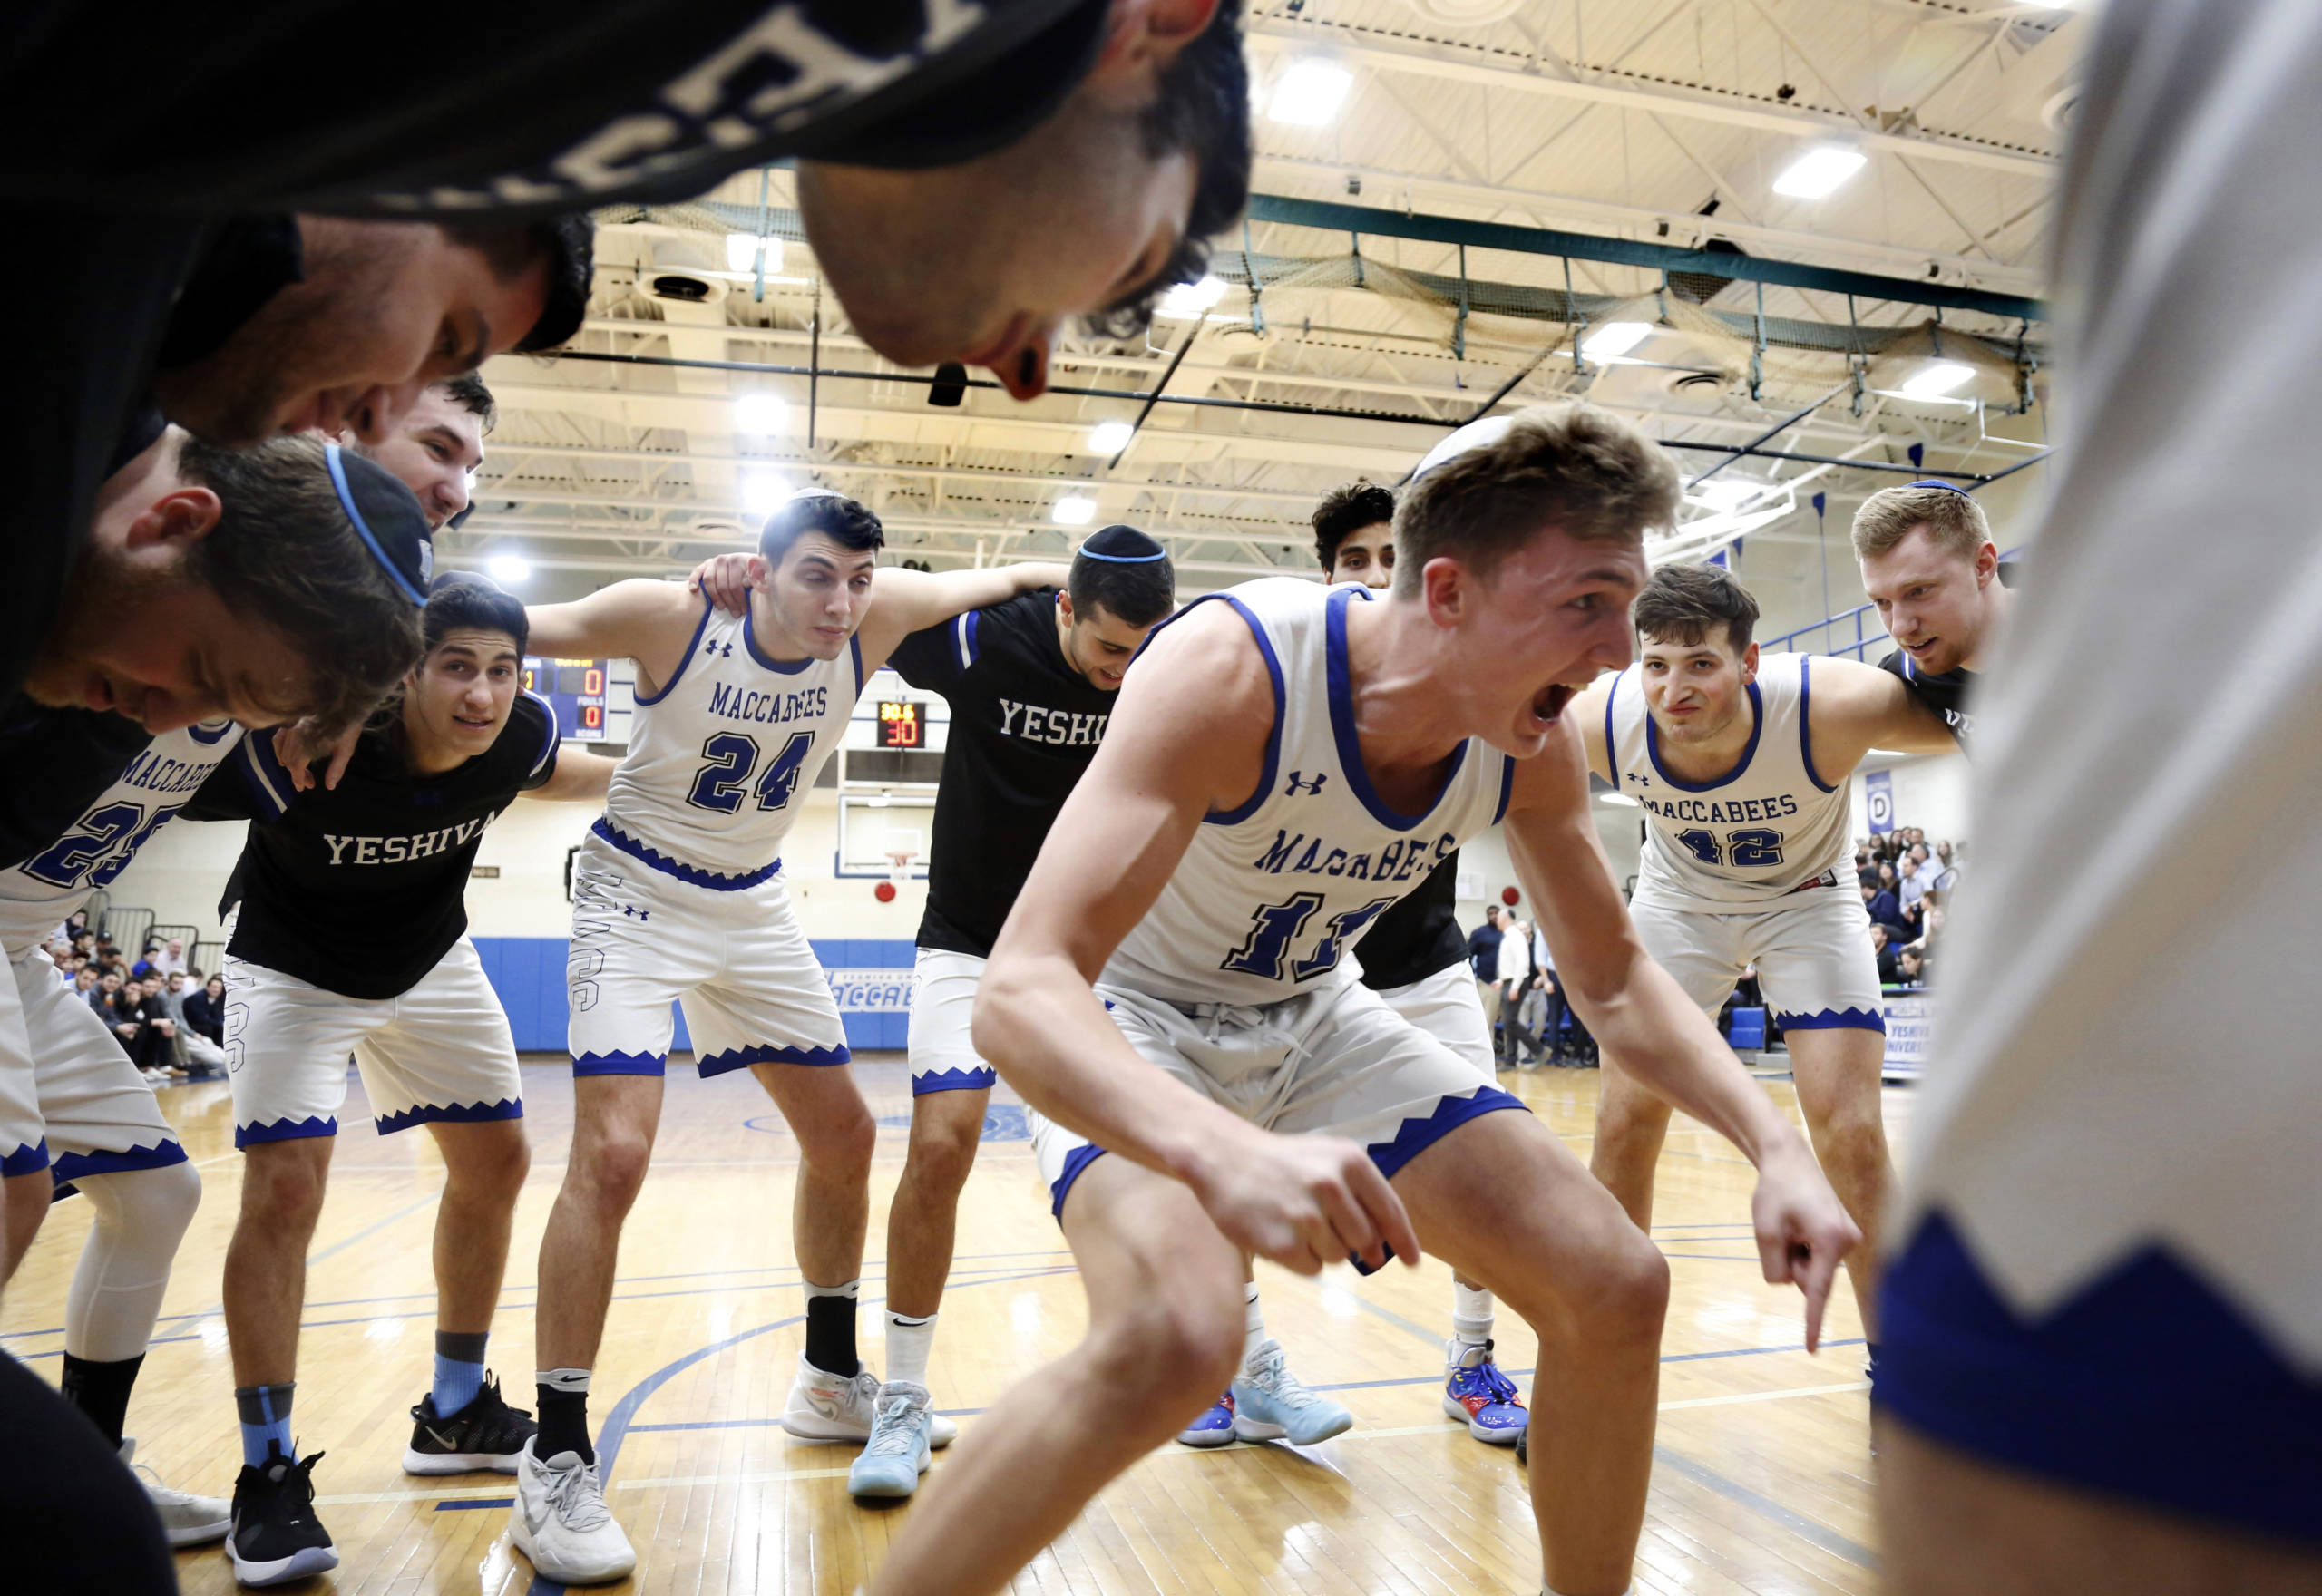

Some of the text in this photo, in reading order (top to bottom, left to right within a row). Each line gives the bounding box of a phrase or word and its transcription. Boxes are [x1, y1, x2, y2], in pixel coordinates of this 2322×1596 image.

[584, 668, 602, 696] 0
[585, 705, 601, 728] 0
[886, 719, 917, 745] 30
[999, 697, 1107, 745] YESHI
[686, 731, 815, 815] 24
[1674, 828, 1784, 867] 42
